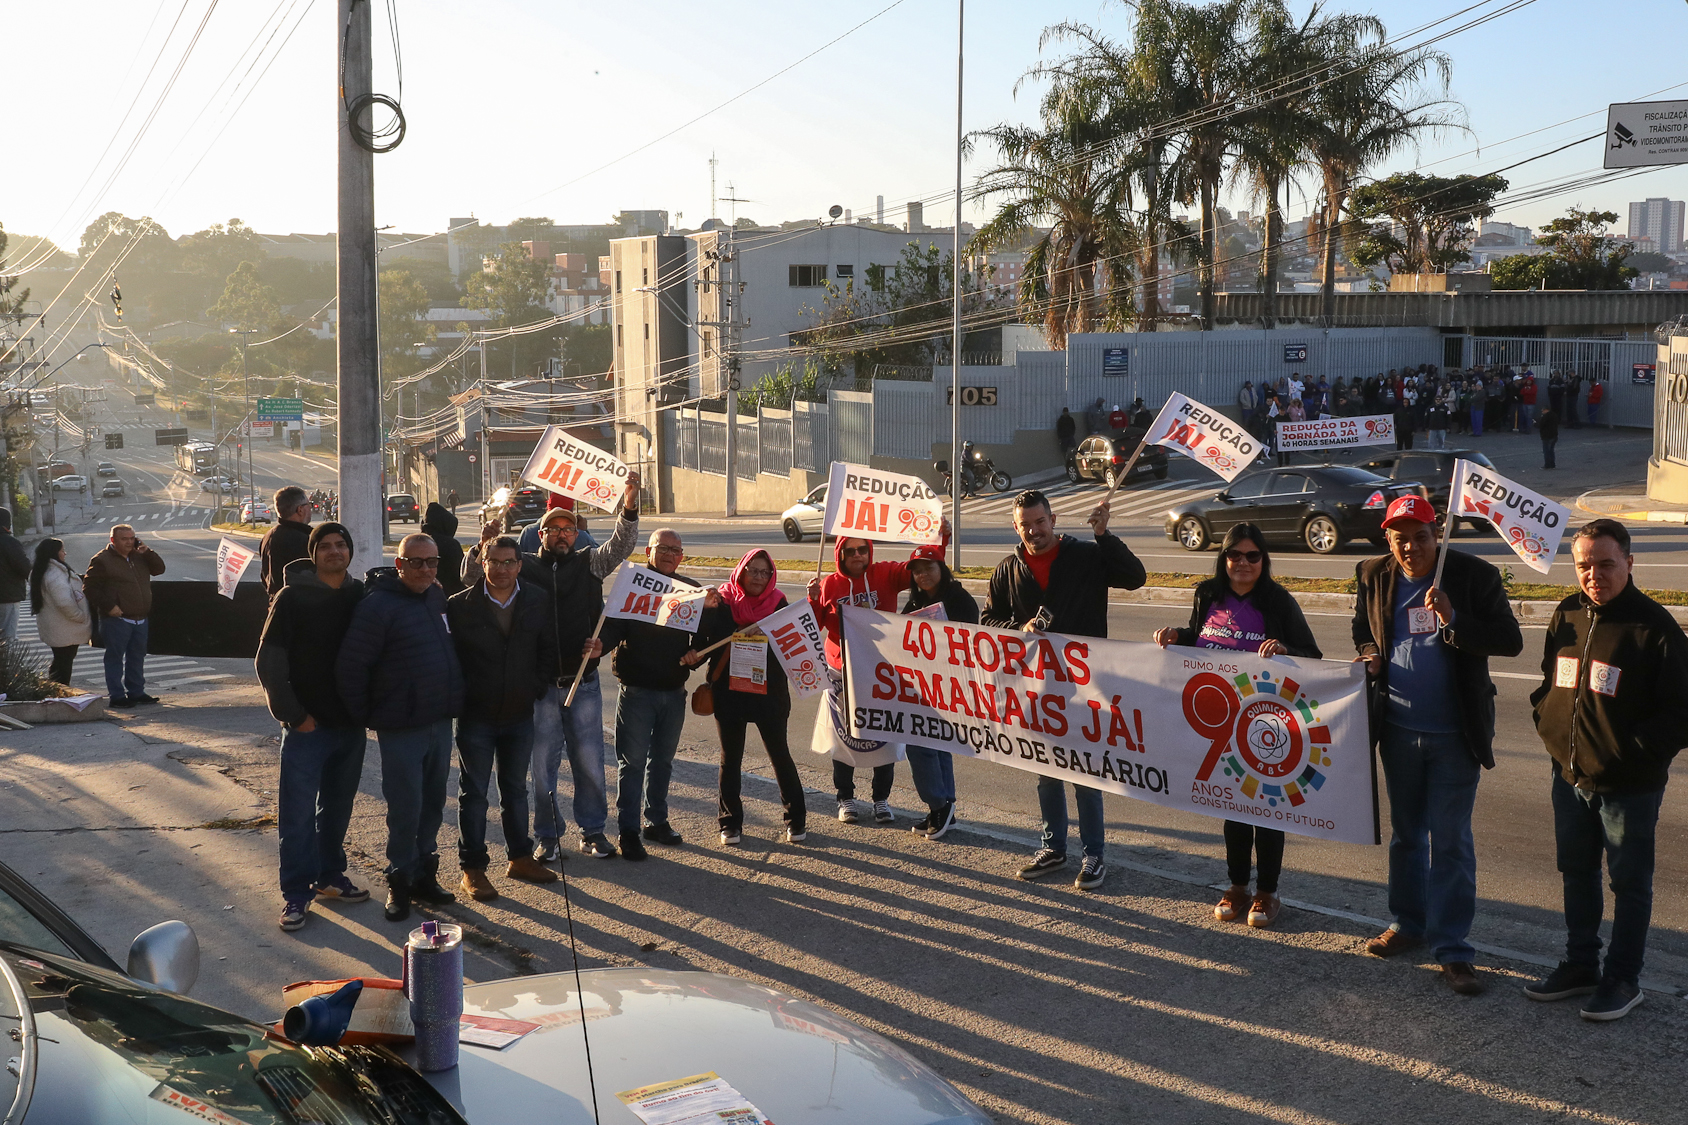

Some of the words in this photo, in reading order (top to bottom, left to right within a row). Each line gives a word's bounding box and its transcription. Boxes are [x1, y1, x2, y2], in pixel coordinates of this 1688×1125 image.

[1649, 123, 1682, 132] TRÂNSITO
[1179, 403, 1252, 455] REDUÇÃO
[1282, 421, 1337, 432] REDUÇÃO
[1282, 431, 1337, 440] JORNADA
[1340, 428, 1358, 436] JÁ!
[1320, 437, 1359, 445] SEMANAIS
[554, 438, 627, 477] REDUÇÃO
[538, 457, 584, 491] JÁ!
[846, 474, 936, 501] REDUÇÃO
[1466, 472, 1559, 528] REDUÇÃO
[841, 496, 889, 532] JÁ!
[226, 551, 248, 575] JÁ!
[620, 592, 662, 617] JÁ!
[770, 622, 808, 660] JÁ!
[903, 620, 936, 660] 40
[944, 626, 1090, 685] HORAS
[1183, 660, 1214, 671] RUMO
[1218, 664, 1238, 674] AOS
[872, 662, 1068, 737] SEMANAIS
[1081, 695, 1145, 753] JÁ!
[1247, 703, 1291, 724] QUÍMICOS
[1182, 672, 1303, 782] 90
[854, 707, 904, 733] SEM
[910, 714, 1013, 755] REDUÇÃO
[1016, 737, 1049, 764] DE
[1052, 746, 1169, 795] SALÁRIO!
[1191, 781, 1233, 799] ANOS
[1191, 795, 1272, 818] CONSTRUINDO
[1275, 811, 1283, 820] O
[1286, 813, 1335, 830] FUTURO
[642, 1088, 667, 1098] Marcha
[642, 1099, 667, 1109] Rumo
